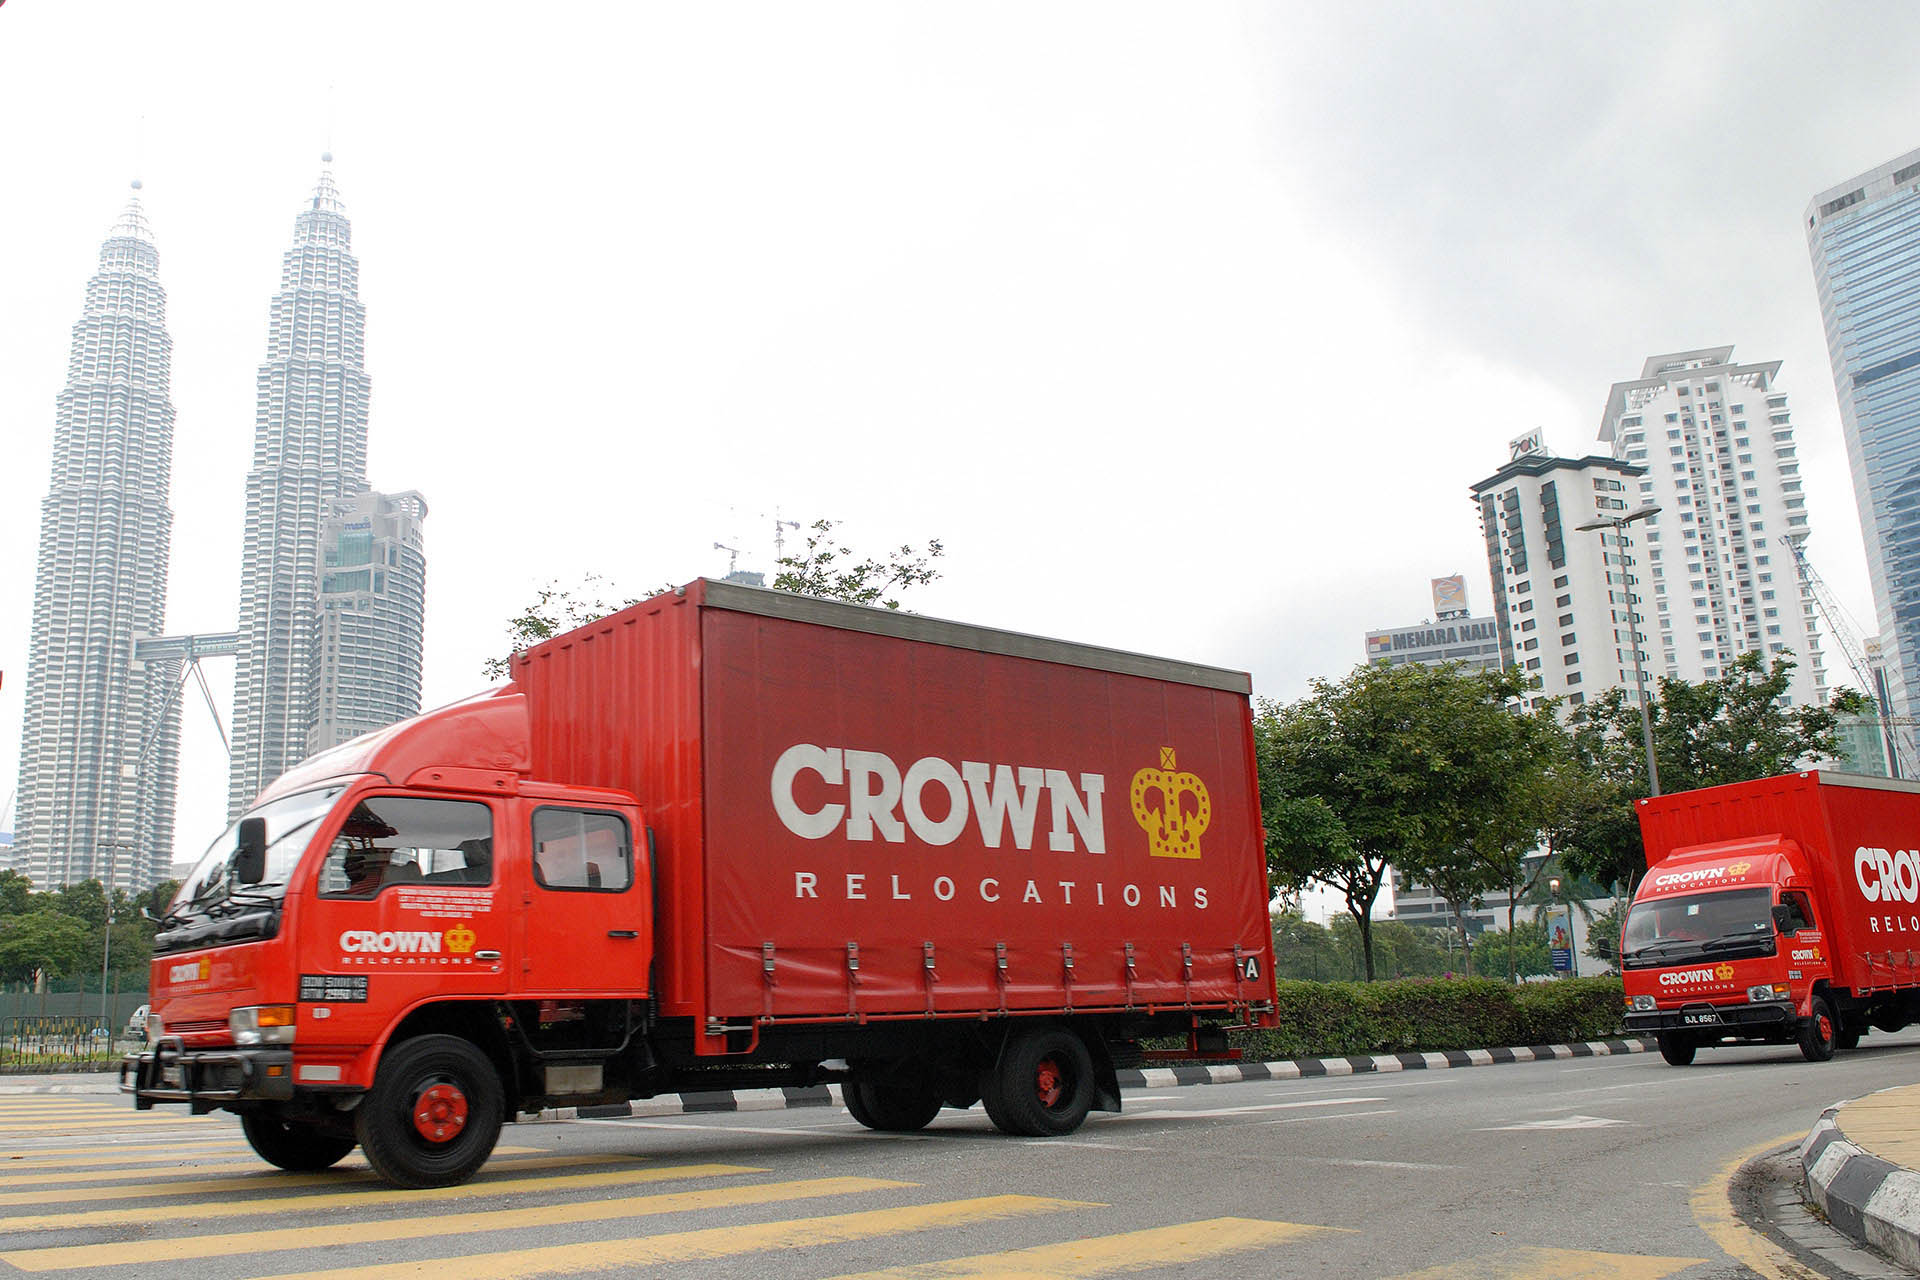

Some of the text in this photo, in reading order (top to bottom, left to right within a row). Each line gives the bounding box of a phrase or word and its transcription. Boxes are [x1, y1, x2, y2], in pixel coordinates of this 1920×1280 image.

[1392, 626, 1458, 651] MENARA
[771, 743, 1106, 855] CROWN
[1655, 866, 1726, 886] CROWN
[1656, 876, 1746, 892] RELOCATIONS
[795, 871, 1209, 910] RELOCATIONS
[1869, 915, 1920, 933] RELO
[339, 930, 443, 953] CROWN
[341, 957, 473, 965] RELOCATIONS
[1791, 949, 1814, 960] CROWN
[1246, 957, 1259, 978] A
[1659, 968, 1714, 986] CROWN
[1663, 983, 1735, 994] RELOCATIONS
[1684, 1014, 1717, 1024] BJL 8567
